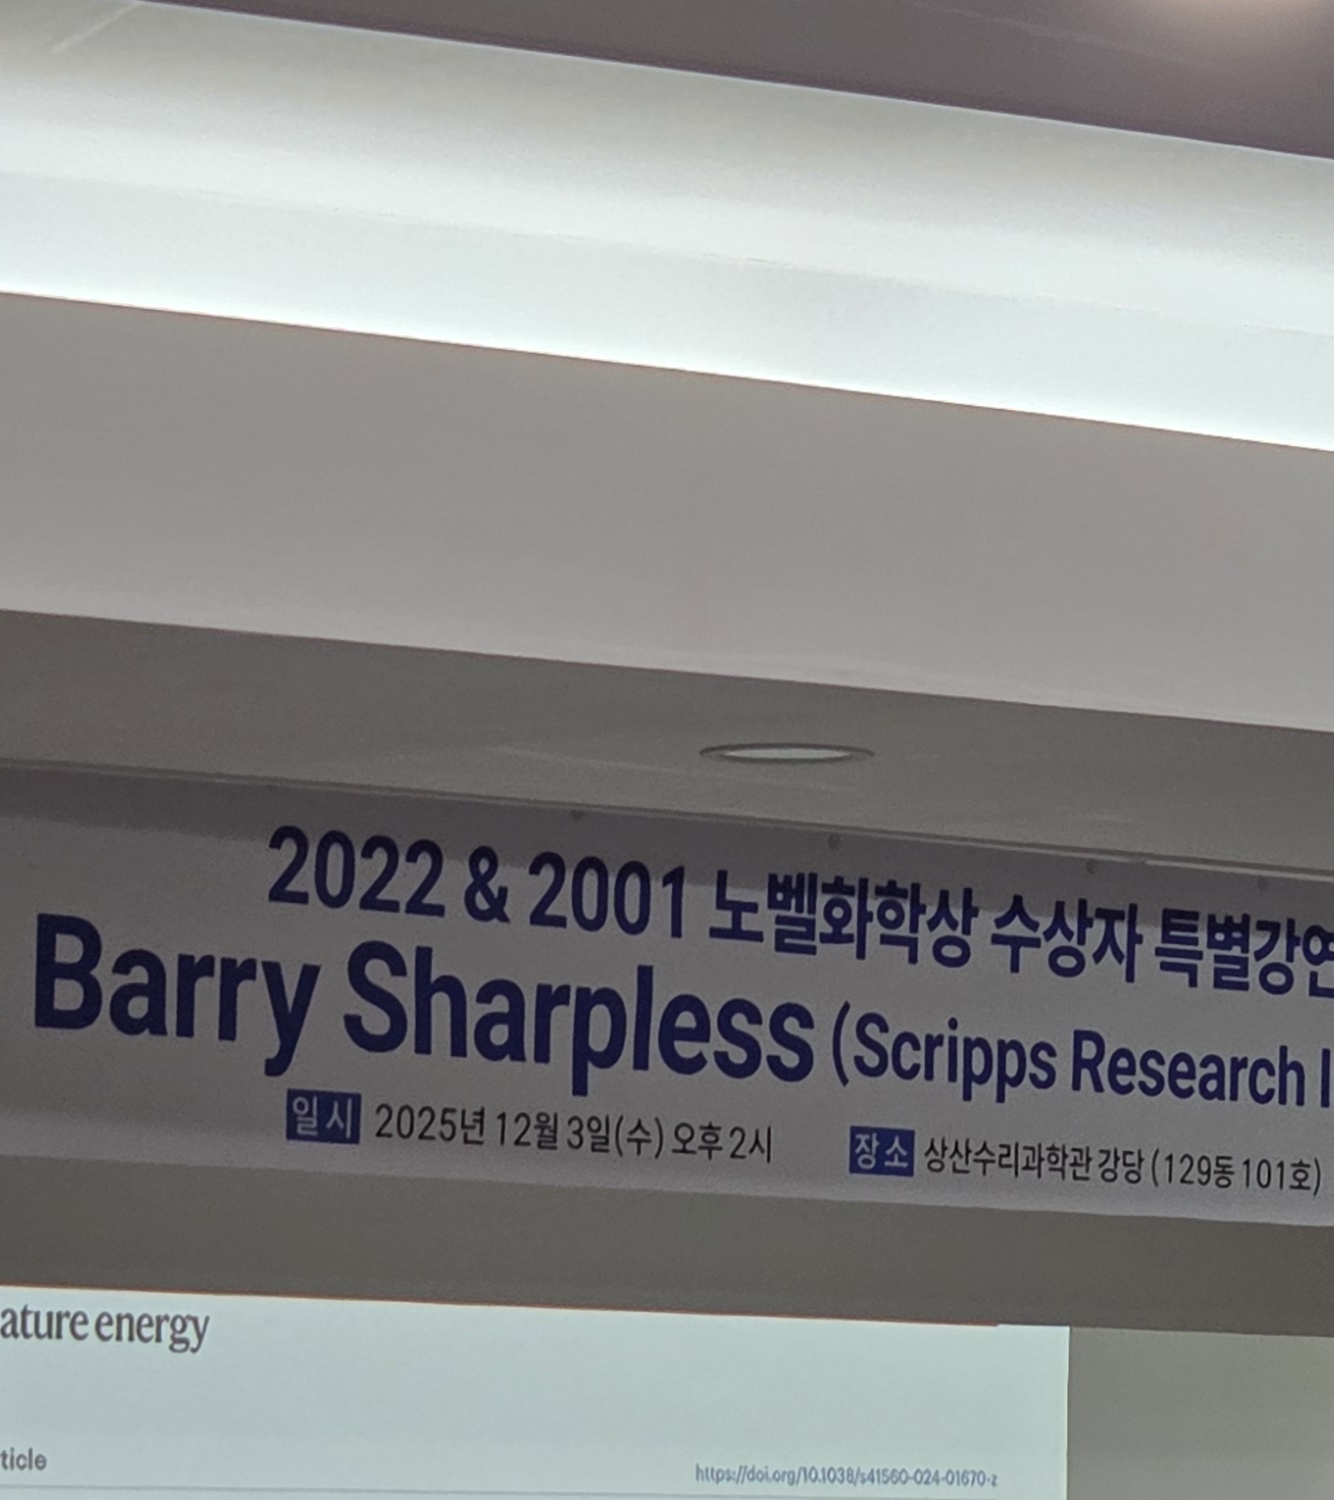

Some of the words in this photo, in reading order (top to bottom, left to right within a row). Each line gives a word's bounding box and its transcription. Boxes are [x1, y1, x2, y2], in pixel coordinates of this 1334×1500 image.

[268, 825, 445, 918] 2022
[464, 845, 510, 924] &
[528, 851, 685, 939] 2001
[708, 869, 979, 968] 노벨화학상
[990, 893, 1144, 983] 수상자
[34, 912, 322, 1077] Barry
[343, 939, 815, 1097] Sharpless
[832, 1000, 1057, 1104] (Scripps
[1070, 1029, 1305, 1106] Research
[292, 1095, 354, 1139] 일시
[374, 1103, 486, 1147] 2025년
[496, 1111, 559, 1151] 12월
[567, 1114, 664, 1160] 3일(수)
[854, 1131, 910, 1171] 장소
[924, 1136, 1093, 1182] 상산수리과학관
[1098, 1145, 1145, 1185] 강당
[94, 1310, 210, 1353] energy
